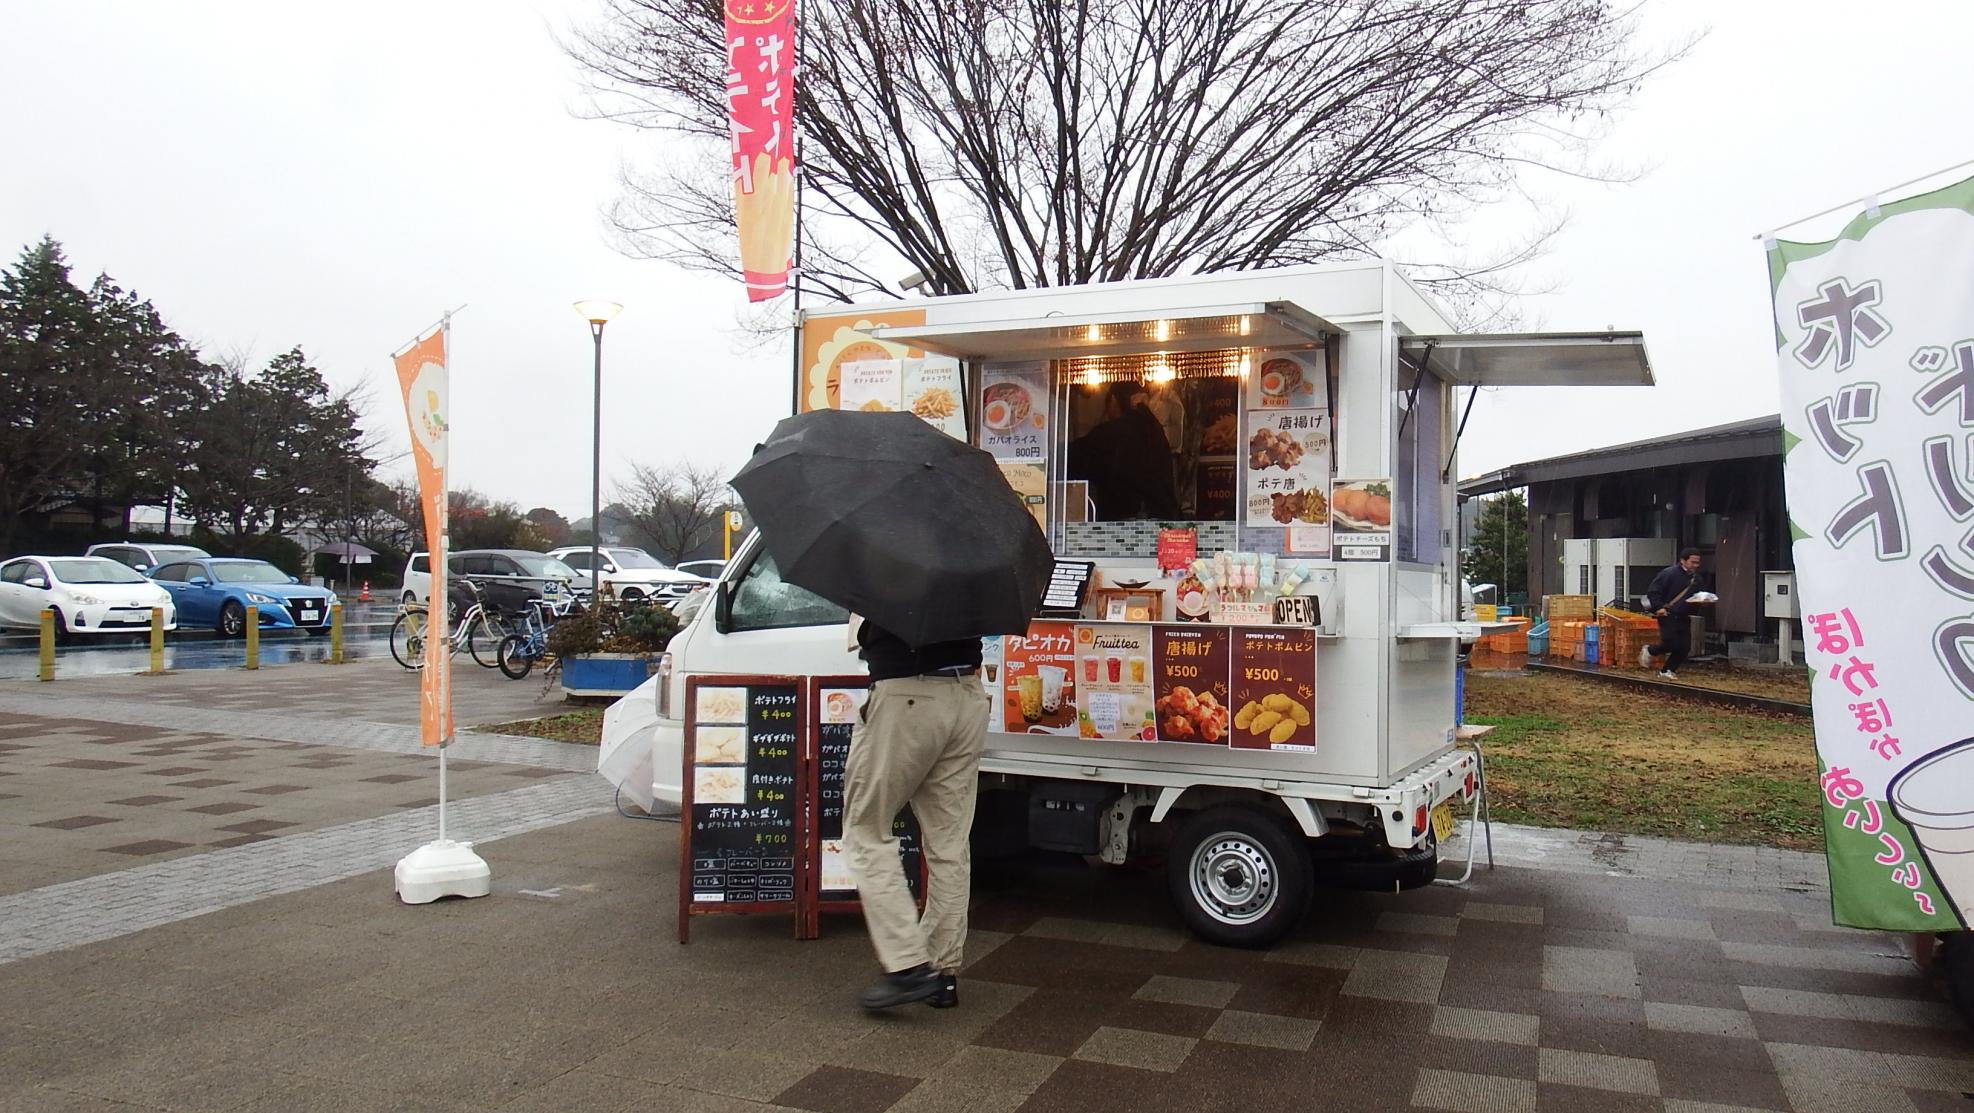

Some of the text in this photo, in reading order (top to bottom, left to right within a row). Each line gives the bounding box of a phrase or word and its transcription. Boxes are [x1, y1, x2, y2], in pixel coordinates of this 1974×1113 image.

[1279, 414, 1324, 430] 唐揚げ
[1278, 599, 1312, 623] OPEN
[1008, 633, 1070, 652] タピオカ
[1166, 640, 1212, 656] 唐揚げ
[1029, 654, 1053, 662] 600円
[1166, 665, 1197, 677] ¥500
[1245, 668, 1279, 681] ¥500
[754, 695, 797, 705] ポテトフライ
[761, 709, 791, 720] ¥400
